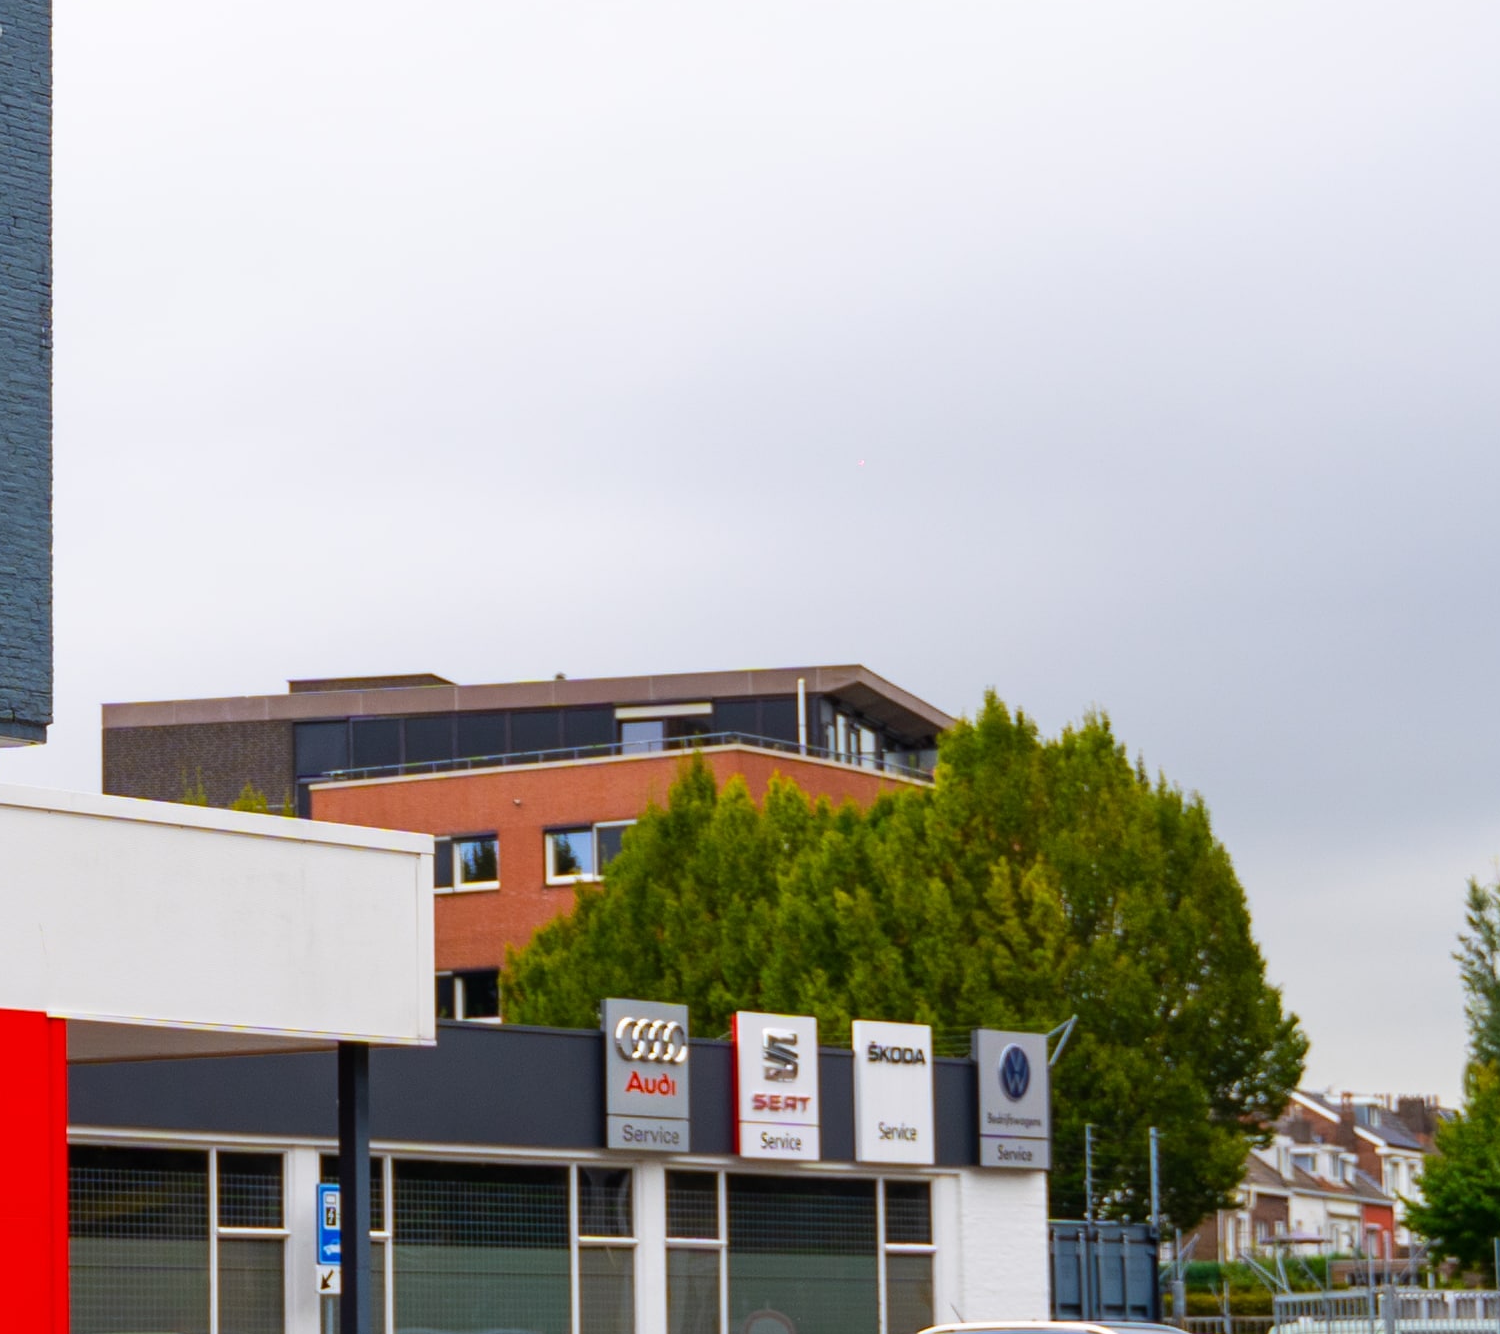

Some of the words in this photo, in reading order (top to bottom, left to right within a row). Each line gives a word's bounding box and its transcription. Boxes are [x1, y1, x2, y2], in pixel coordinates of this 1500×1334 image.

[868, 1041, 926, 1065] ŠKODA
[625, 1071, 677, 1096] Audi
[752, 1093, 811, 1112] SEAT
[622, 1124, 680, 1145] Service
[761, 1131, 802, 1151] Service
[878, 1122, 917, 1142] Service
[997, 1144, 1033, 1162] Service
